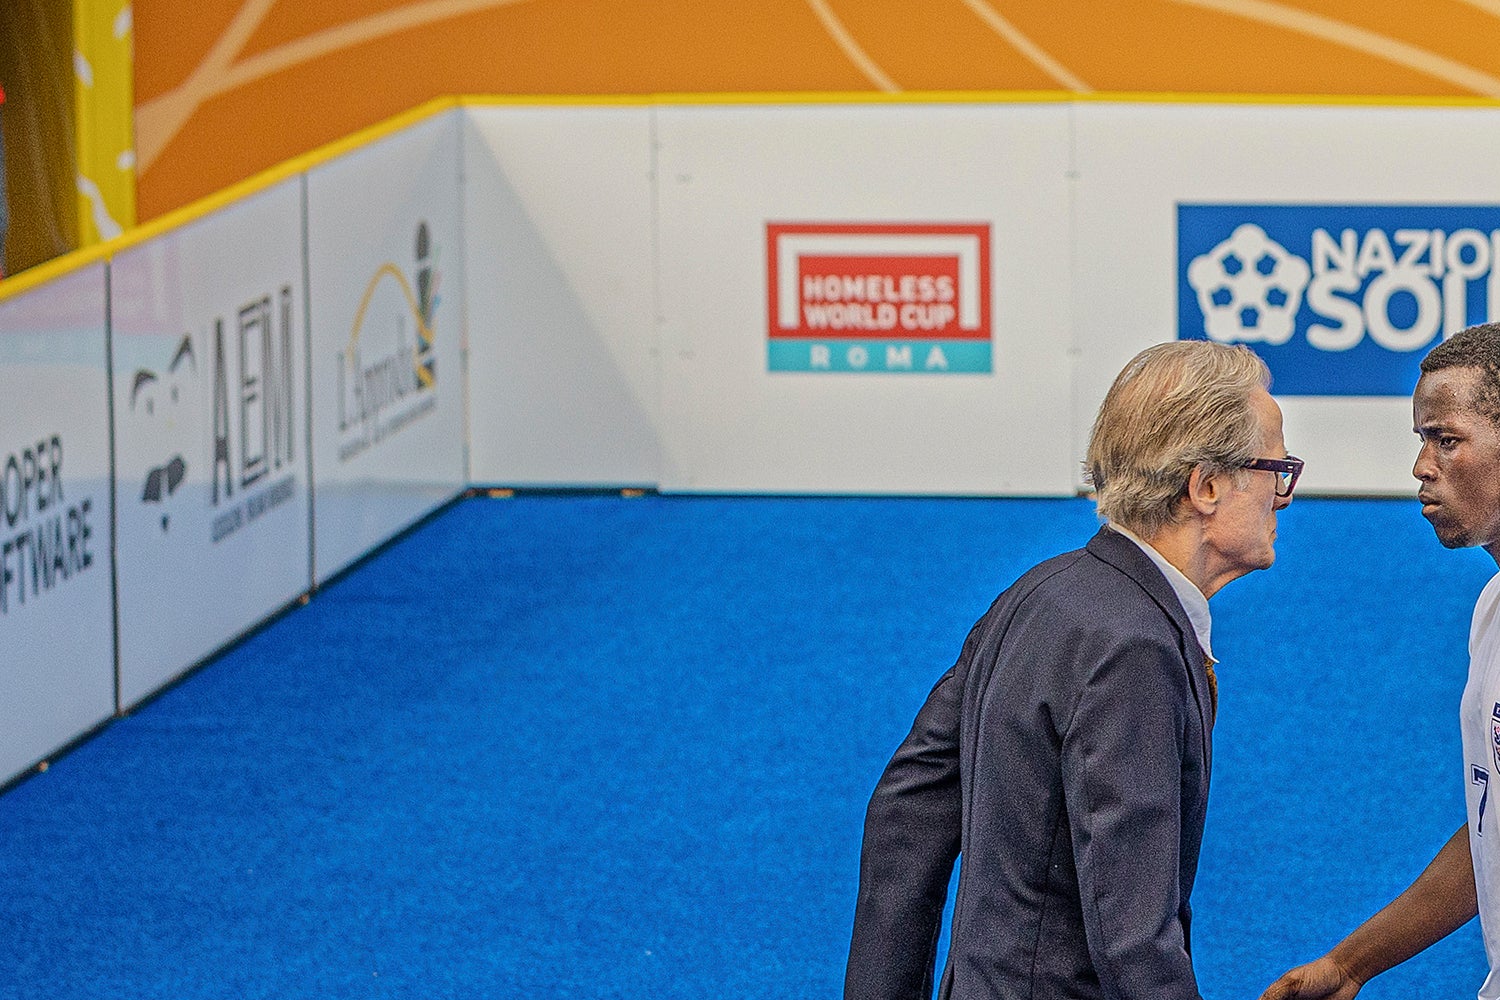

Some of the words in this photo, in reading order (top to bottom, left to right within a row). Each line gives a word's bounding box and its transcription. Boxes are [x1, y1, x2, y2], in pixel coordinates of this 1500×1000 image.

[803, 274, 955, 303] HOMELESS
[803, 303, 898, 330] WORLD
[900, 303, 956, 330] CUP
[810, 345, 949, 369] ROMA
[0, 434, 64, 528] OPER
[0, 497, 93, 616] FTWARE
[1470, 764, 1490, 837] 7
